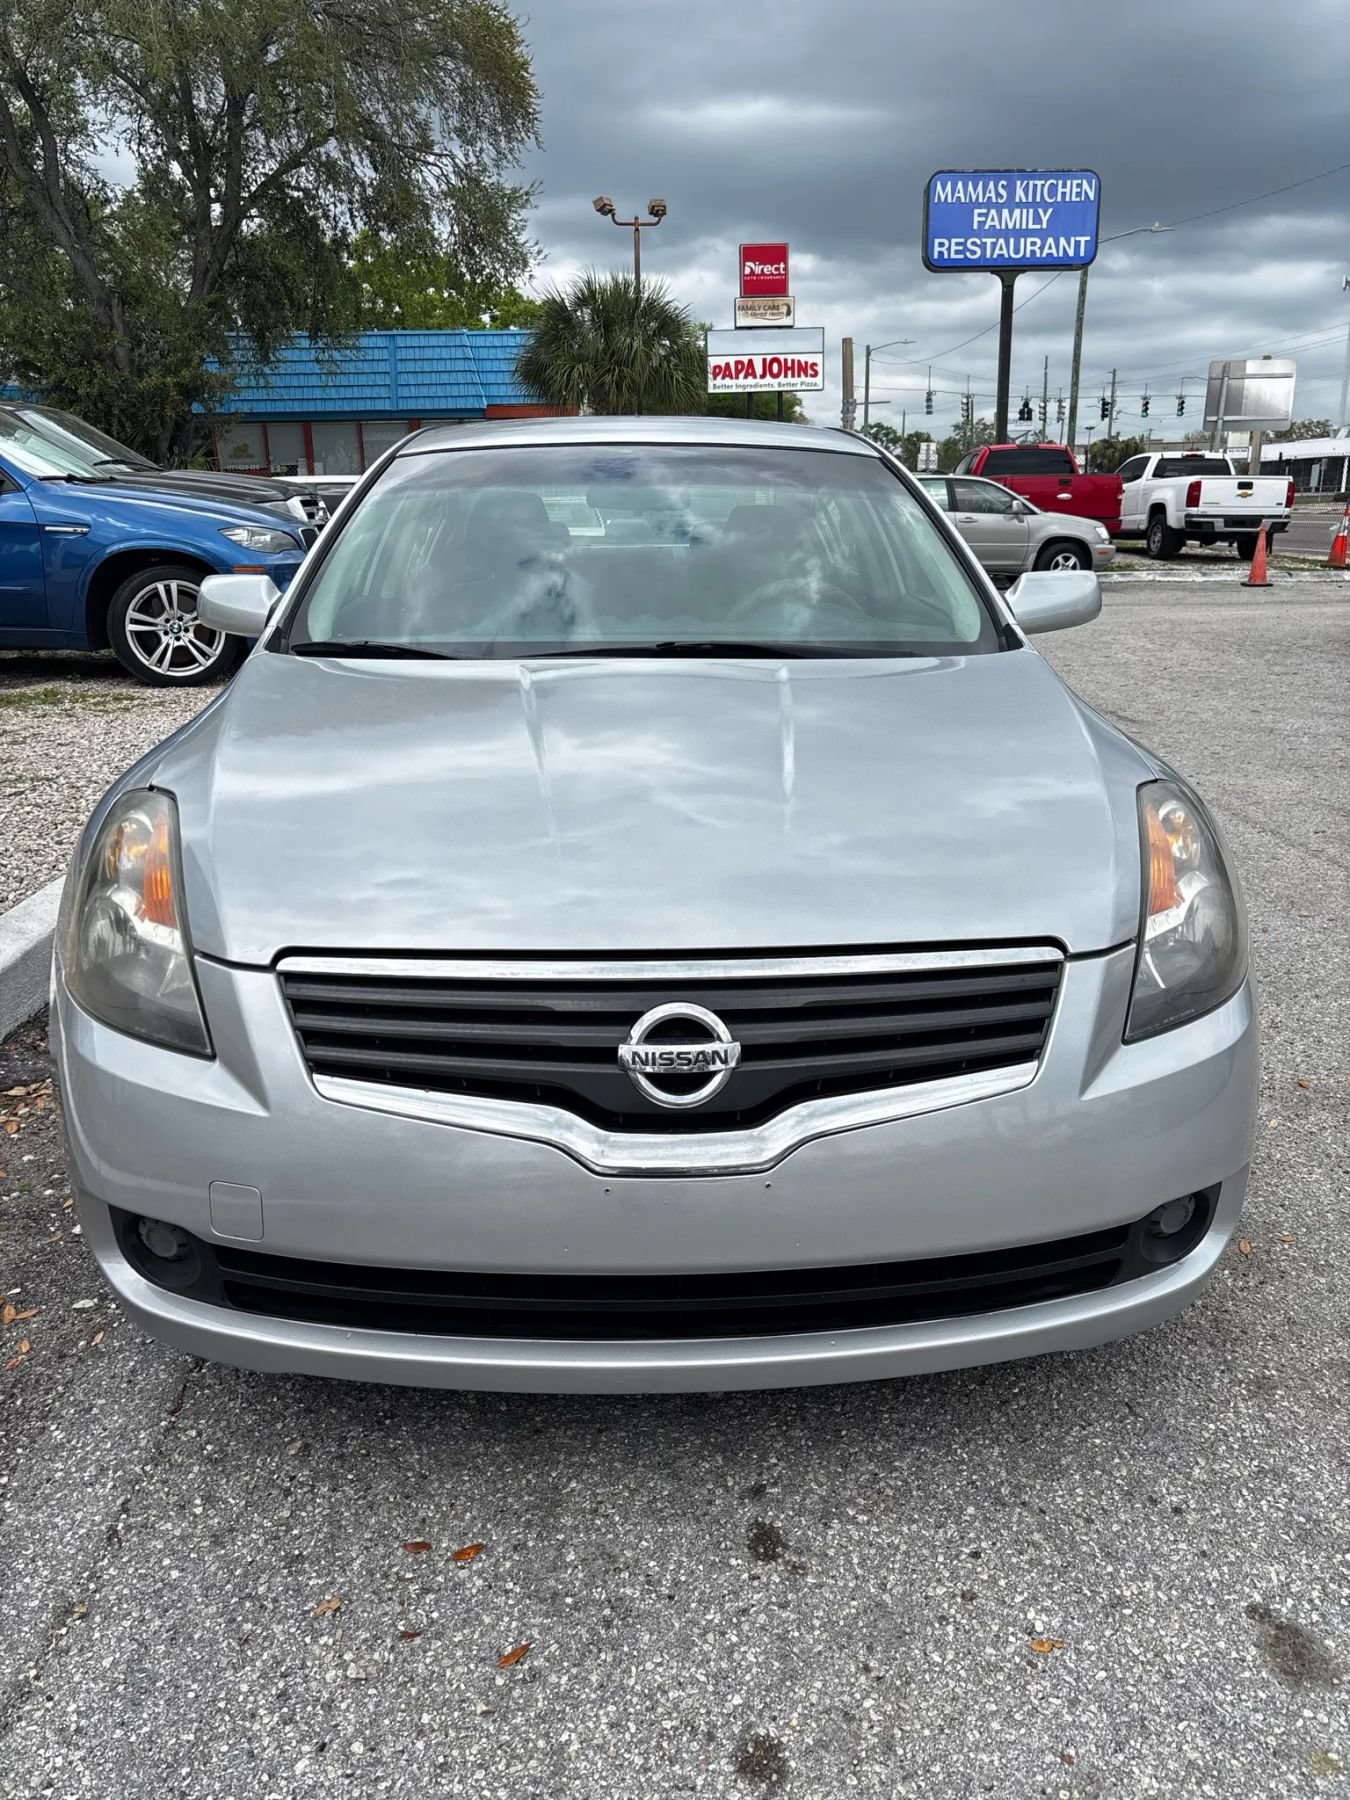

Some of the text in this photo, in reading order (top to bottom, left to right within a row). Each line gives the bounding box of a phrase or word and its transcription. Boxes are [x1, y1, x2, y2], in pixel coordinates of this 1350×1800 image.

[934, 178, 1096, 204] MAMAS KITCHEN
[972, 207, 1054, 230] FAMILY
[933, 236, 1091, 260] RESTAURANT
[744, 261, 786, 275] Direct
[737, 303, 780, 312] FAMILY CARE
[712, 356, 819, 381] PAPA JOHNS
[735, 382, 775, 391] Ingredients.
[777, 381, 798, 389] Better
[631, 1049, 729, 1067] NISSAN
